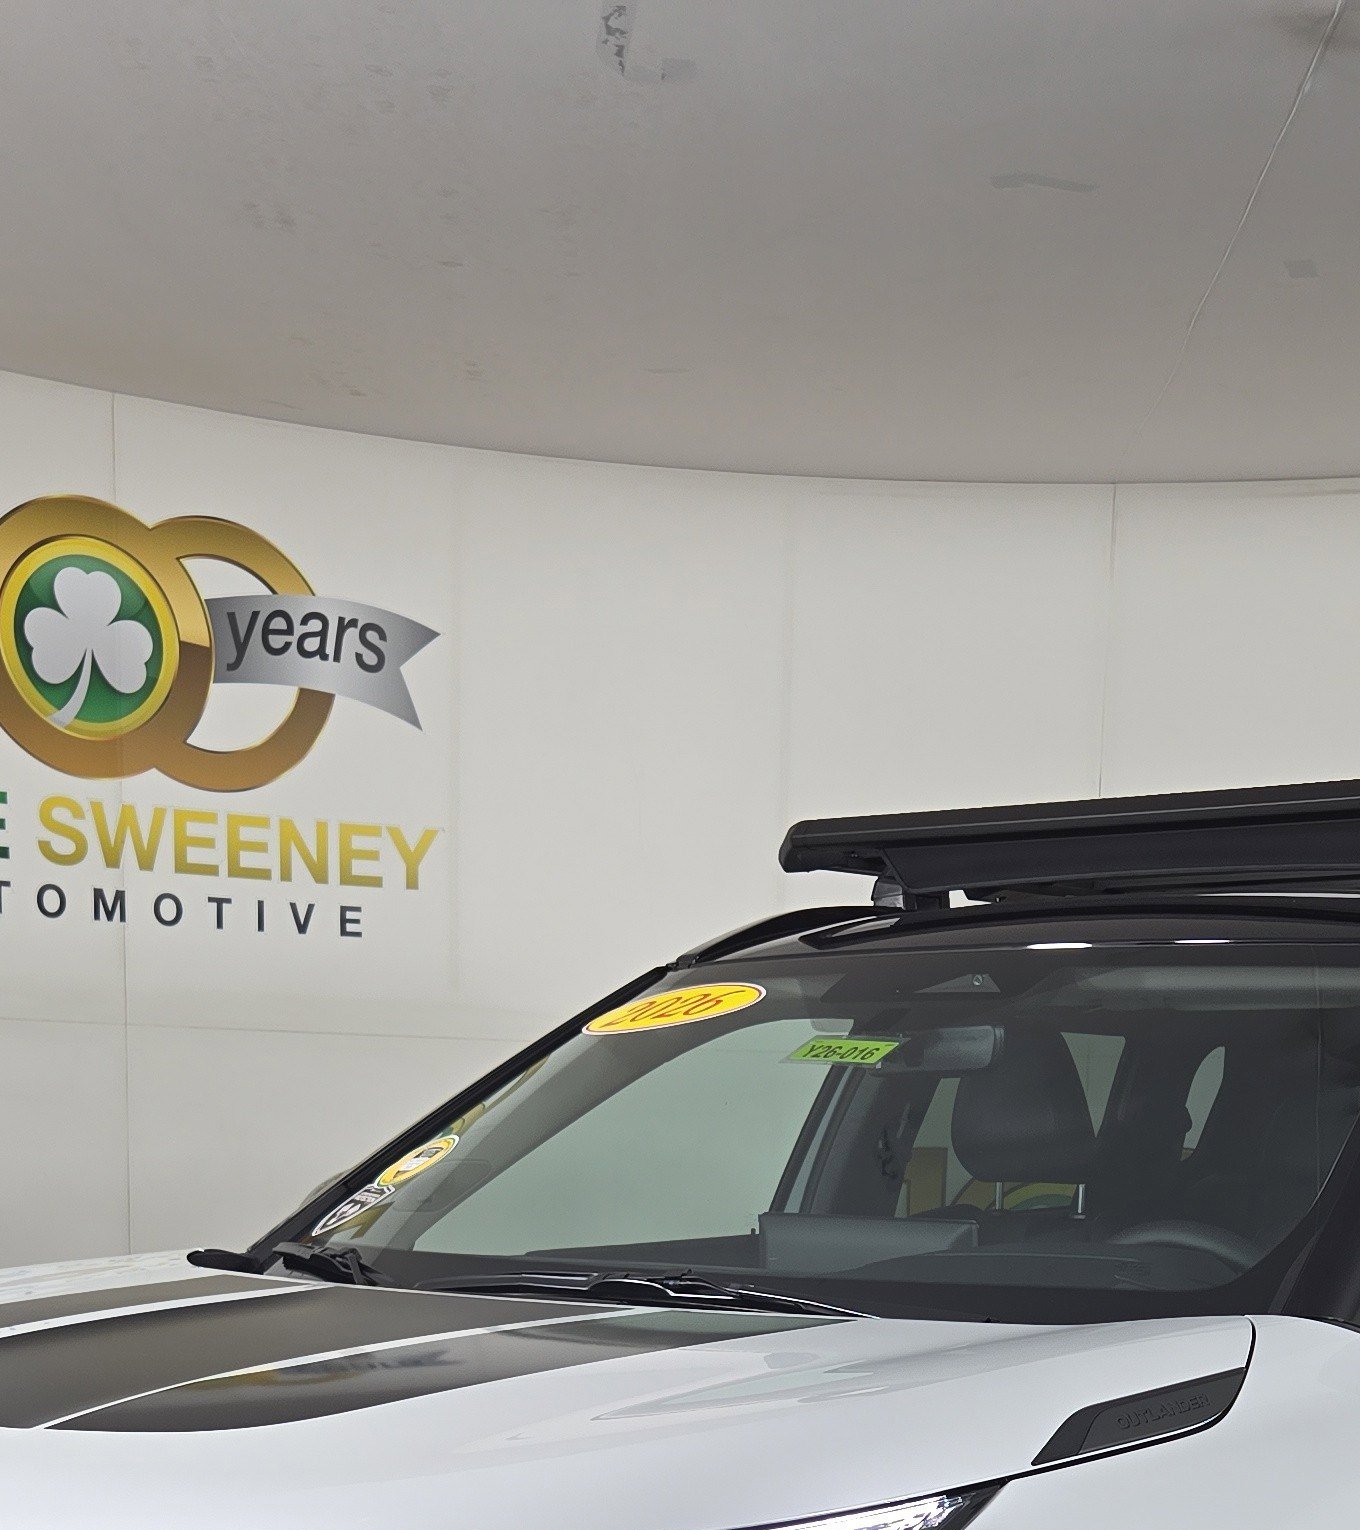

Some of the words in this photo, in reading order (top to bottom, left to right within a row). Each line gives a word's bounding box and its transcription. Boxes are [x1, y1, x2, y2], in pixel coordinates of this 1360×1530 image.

[224, 608, 388, 673] years
[37, 795, 440, 890] SWEENEY
[599, 989, 747, 1029] 2026
[802, 1044, 881, 1061] Y26-016
[1116, 1392, 1211, 1429] OUTLANDER
